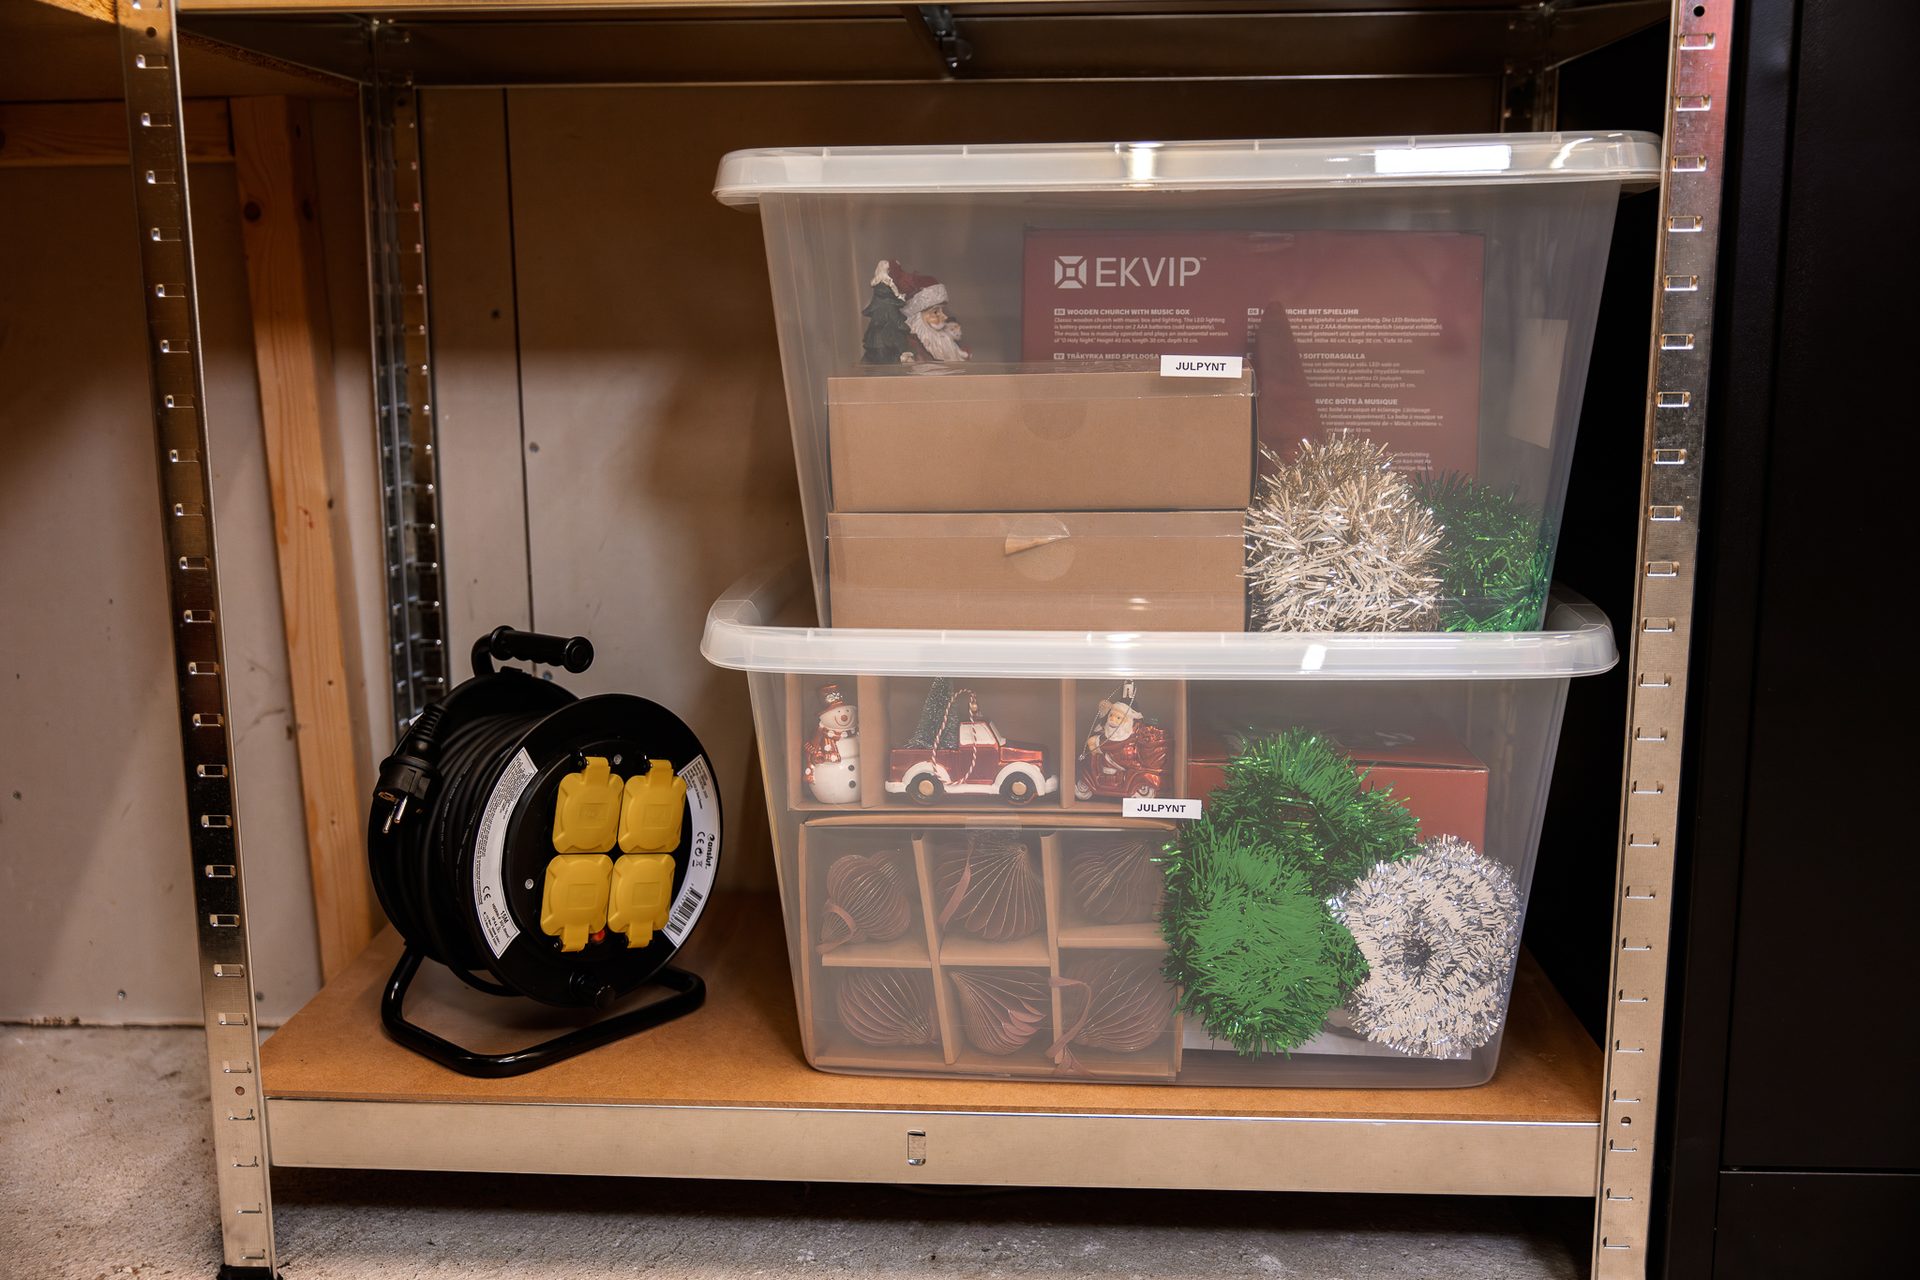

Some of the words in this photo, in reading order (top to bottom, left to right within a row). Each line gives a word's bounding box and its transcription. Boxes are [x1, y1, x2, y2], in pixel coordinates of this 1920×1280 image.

[1096, 257, 1201, 286] EKVIP
[1176, 362, 1226, 371] JULPYNT
[1137, 804, 1186, 812] JULPYNT
